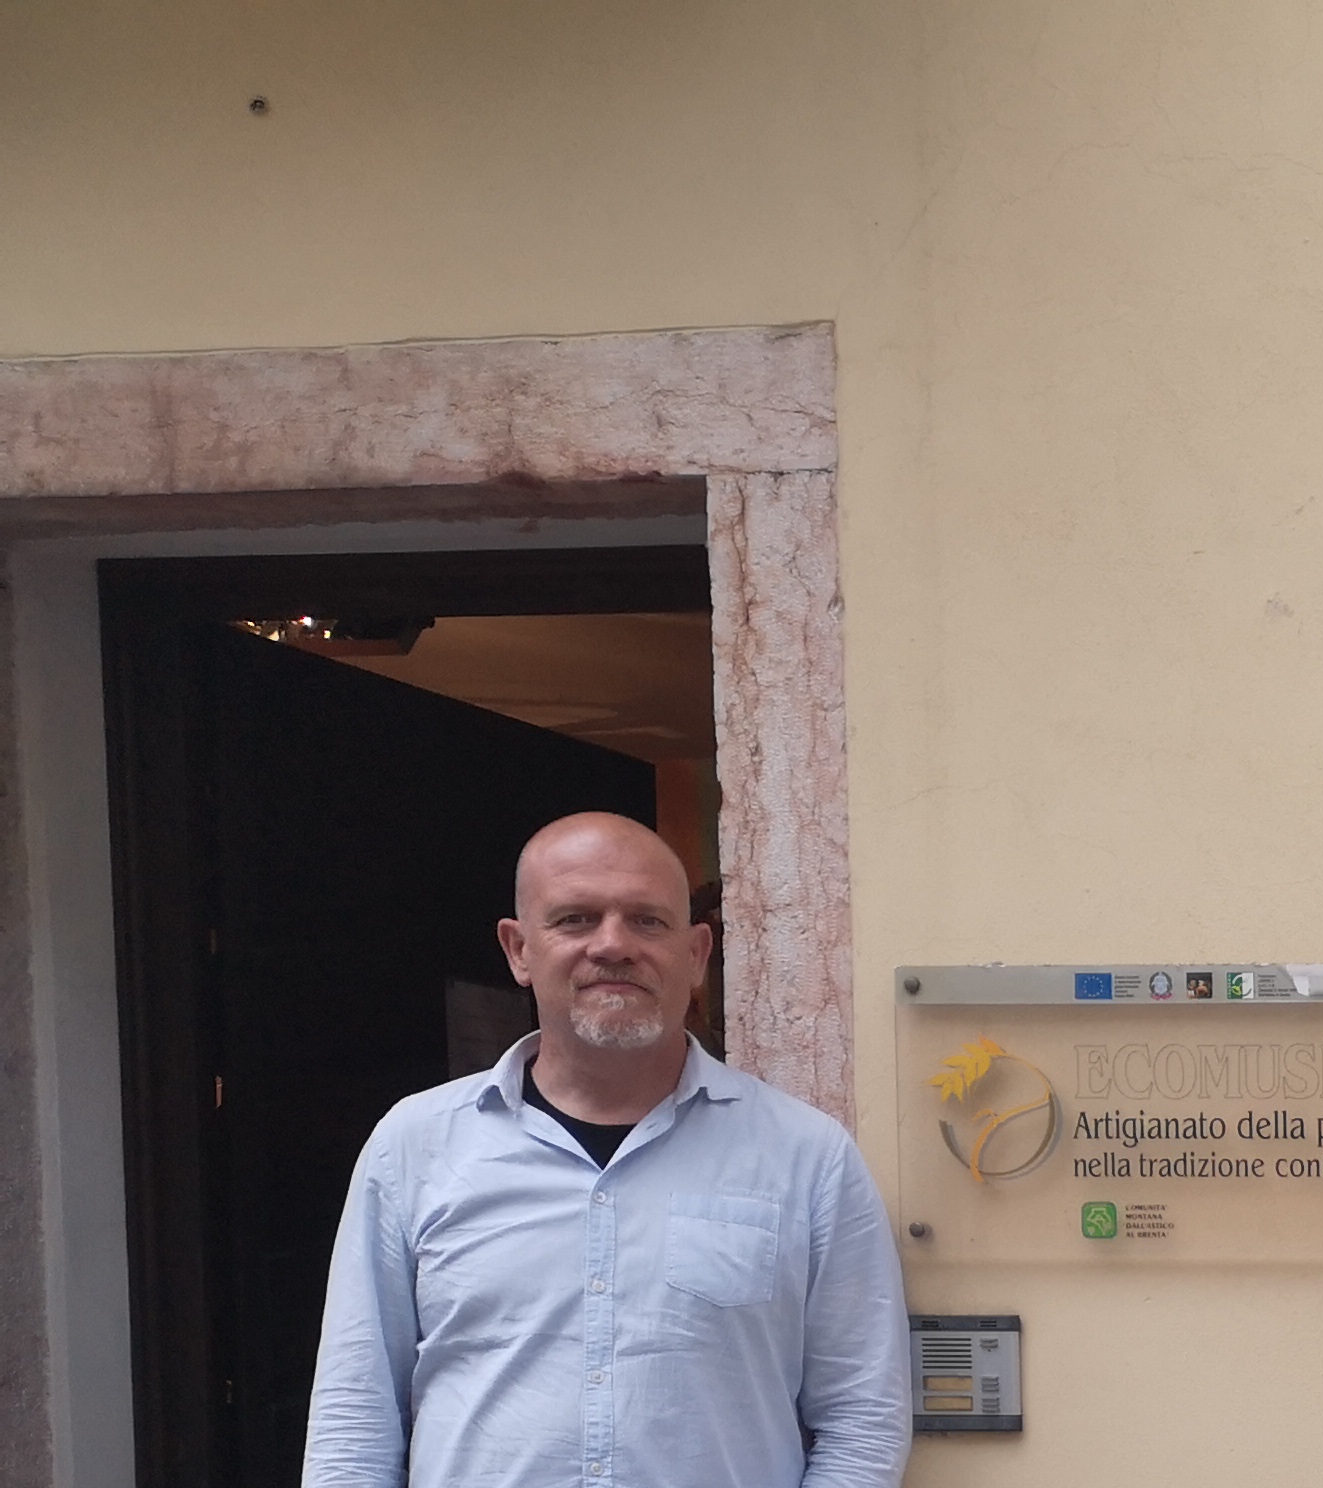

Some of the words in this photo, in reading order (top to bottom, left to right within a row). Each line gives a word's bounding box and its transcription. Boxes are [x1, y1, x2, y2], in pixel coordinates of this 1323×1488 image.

[1073, 1110, 1226, 1148] Artigianato
[1237, 1110, 1306, 1140] della
[1073, 1152, 1131, 1178] nella
[1139, 1152, 1265, 1178] tradizione
